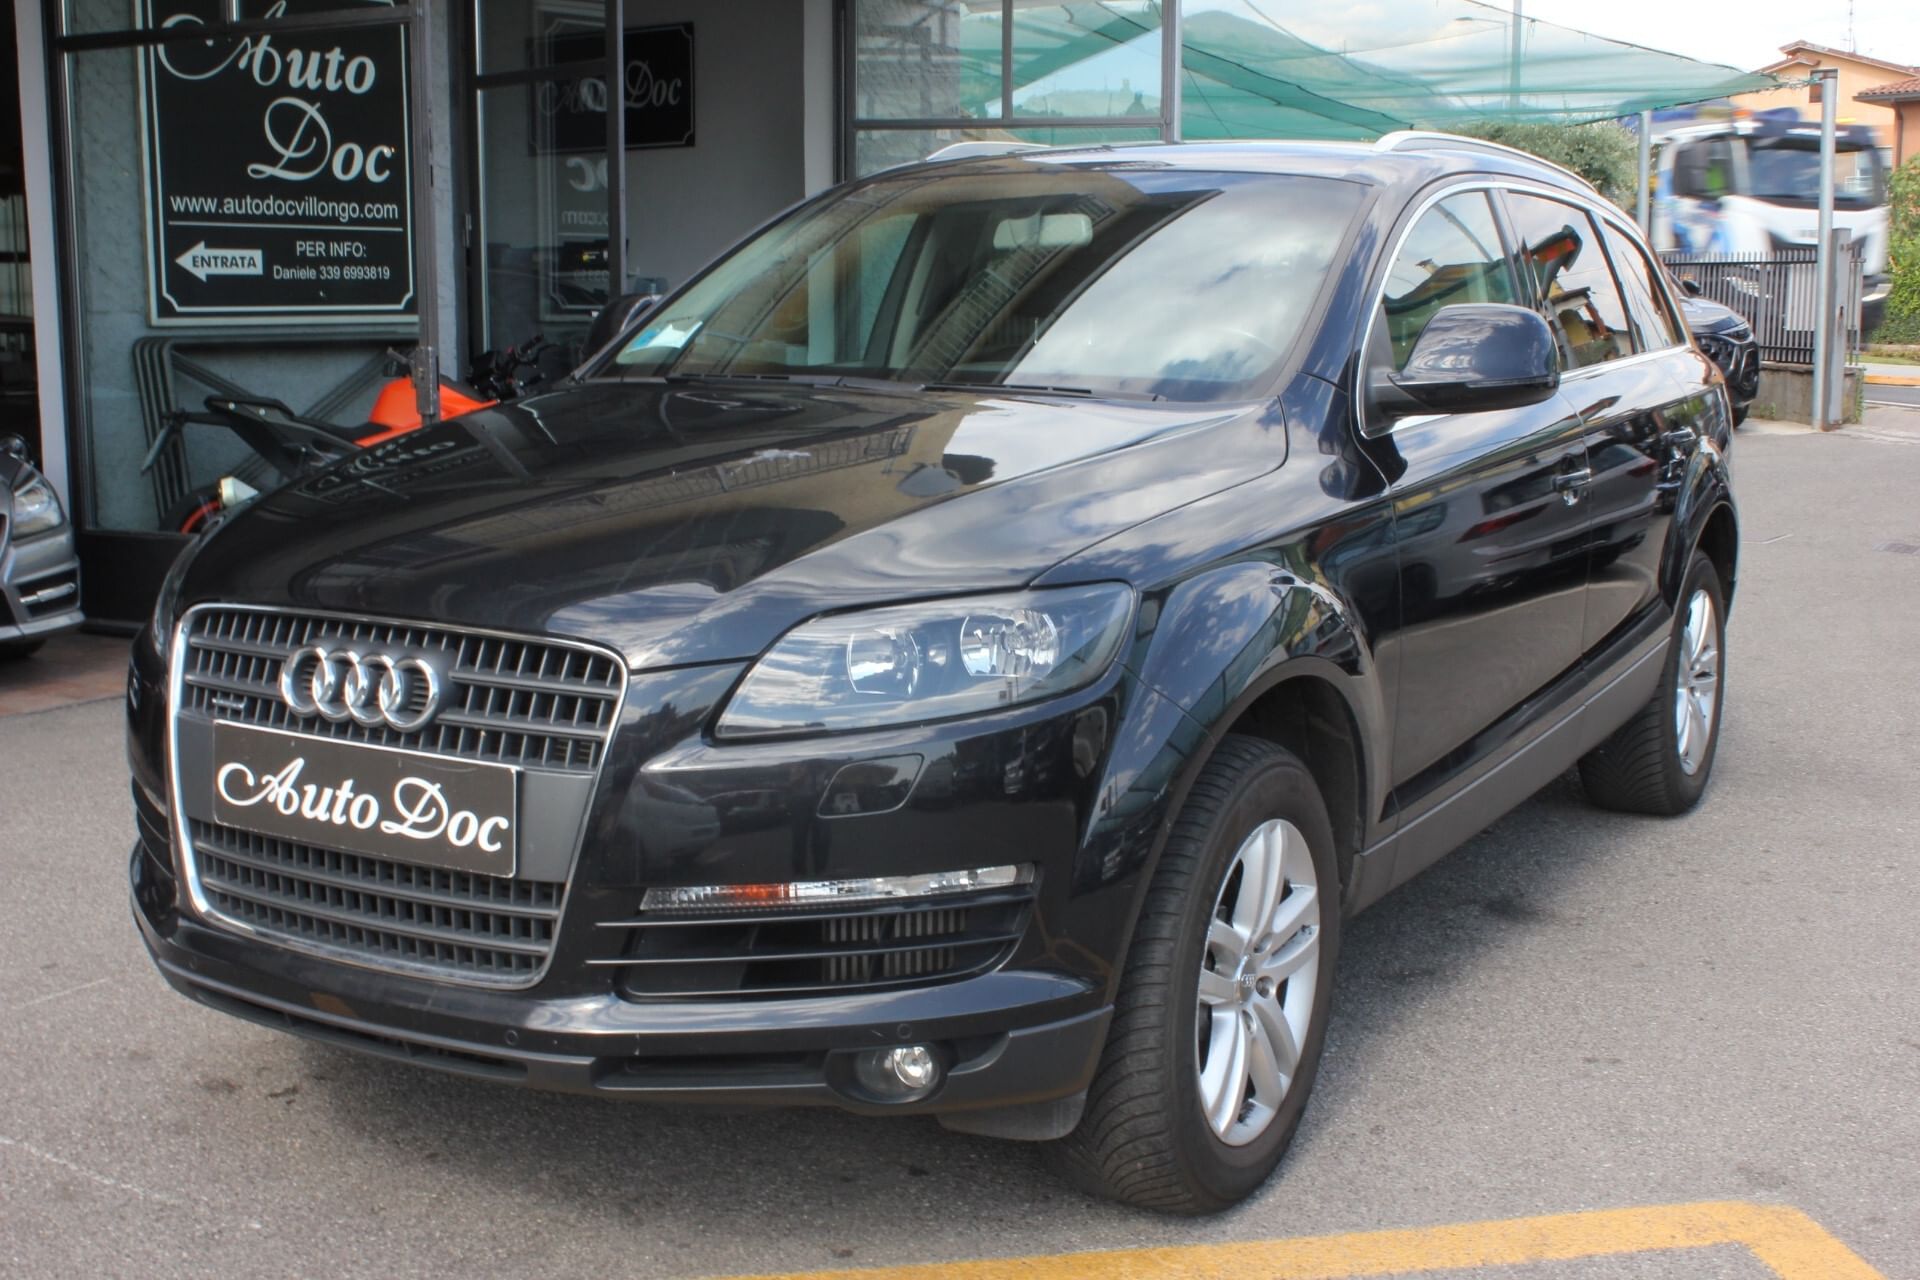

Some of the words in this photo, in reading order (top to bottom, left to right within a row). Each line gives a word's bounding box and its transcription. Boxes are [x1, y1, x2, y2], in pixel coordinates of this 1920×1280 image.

[157, 0, 376, 94] Auto
[247, 96, 392, 183] Doc
[170, 195, 399, 222] www.autodocvillongo.com
[192, 255, 257, 268] ENTRATA
[296, 241, 326, 256] PER
[330, 242, 367, 257] INFO:
[273, 265, 317, 280] Daniele
[319, 266, 341, 280] 339
[343, 266, 390, 280] 6993819
[217, 757, 379, 829] Auto
[380, 777, 509, 852] Doc
